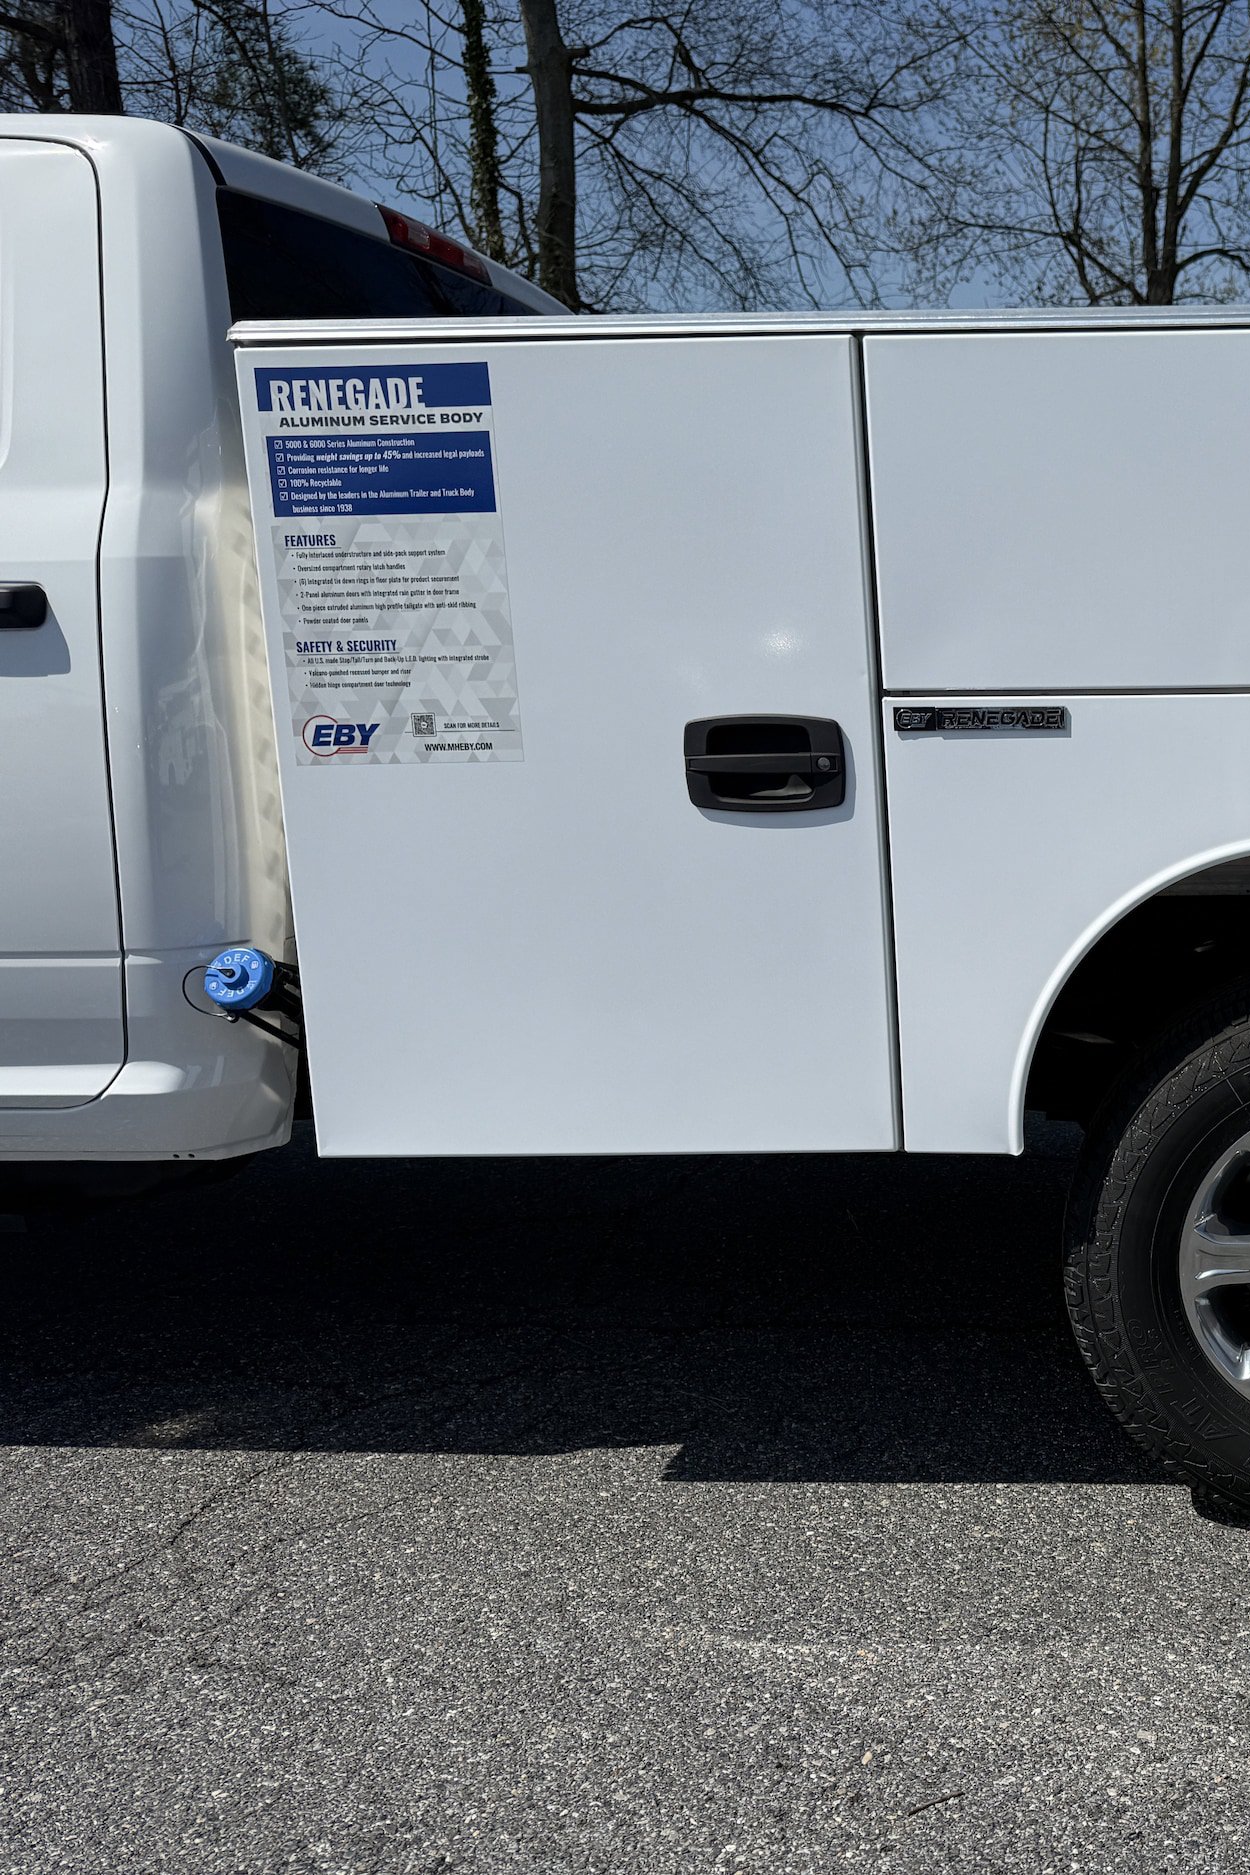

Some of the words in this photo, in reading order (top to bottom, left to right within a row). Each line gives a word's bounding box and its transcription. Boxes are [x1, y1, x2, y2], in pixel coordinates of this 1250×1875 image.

[269, 377, 426, 412] RENEGADE
[279, 416, 365, 428] ALUMINUM
[370, 414, 436, 425] SERVICE
[441, 412, 483, 423] BODY
[310, 440, 325, 448] 6000
[347, 439, 376, 447] Aluminum
[377, 439, 415, 447] Construction
[287, 453, 314, 463] Providing
[316, 453, 337, 462] weight
[340, 453, 363, 461] savings
[364, 453, 373, 461] up
[374, 452, 381, 460] to
[383, 451, 401, 459] 45%
[402, 451, 412, 459] and
[414, 450, 442, 458] increased
[443, 450, 457, 459] legal
[459, 449, 484, 459] payloads
[288, 466, 316, 474] Corrosion
[318, 466, 347, 474] resistance
[349, 465, 357, 473] for
[359, 465, 377, 474] longer
[290, 479, 308, 487] 100%
[310, 478, 341, 488] Recyclable
[291, 492, 317, 501] Designed
[319, 492, 326, 501] by
[327, 491, 337, 499] the
[339, 491, 360, 499] leaders
[379, 490, 409, 498] Aluminum
[410, 489, 428, 497] Trailer
[430, 489, 441, 497] and
[442, 488, 458, 496] Truck
[460, 488, 474, 497] Body
[293, 505, 318, 513] business
[320, 505, 335, 513] since
[337, 504, 352, 512] 1938
[285, 535, 336, 547] FEATURES
[296, 552, 308, 560] Fully
[408, 549, 427, 557] support
[428, 549, 445, 557] system
[323, 564, 355, 572] compartment
[388, 576, 401, 584] plate
[321, 590, 344, 598] aluminum
[373, 589, 398, 597] integrated
[327, 603, 349, 611] extruded
[375, 602, 386, 611] high
[387, 602, 403, 610] profile
[404, 602, 423, 610] tailgate
[459, 601, 476, 609] ribbing
[296, 640, 332, 653] SAFETY
[336, 641, 344, 652] &
[347, 640, 397, 652] SECURITY
[375, 655, 383, 663] and
[418, 655, 436, 663] lighting
[438, 654, 448, 662] with
[372, 668, 389, 676] bumper
[310, 681, 326, 689] Hidden
[328, 681, 340, 689] hinge
[342, 681, 373, 689] compartment
[374, 680, 384, 688] door
[386, 680, 410, 688] technology
[900, 713, 932, 723] EBY
[942, 709, 1064, 728] RENEGADE
[312, 723, 380, 746] EBY
[425, 742, 492, 751] WWW.MHEBY.COM
[224, 953, 250, 964] DEF
[217, 989, 245, 997] DEF
